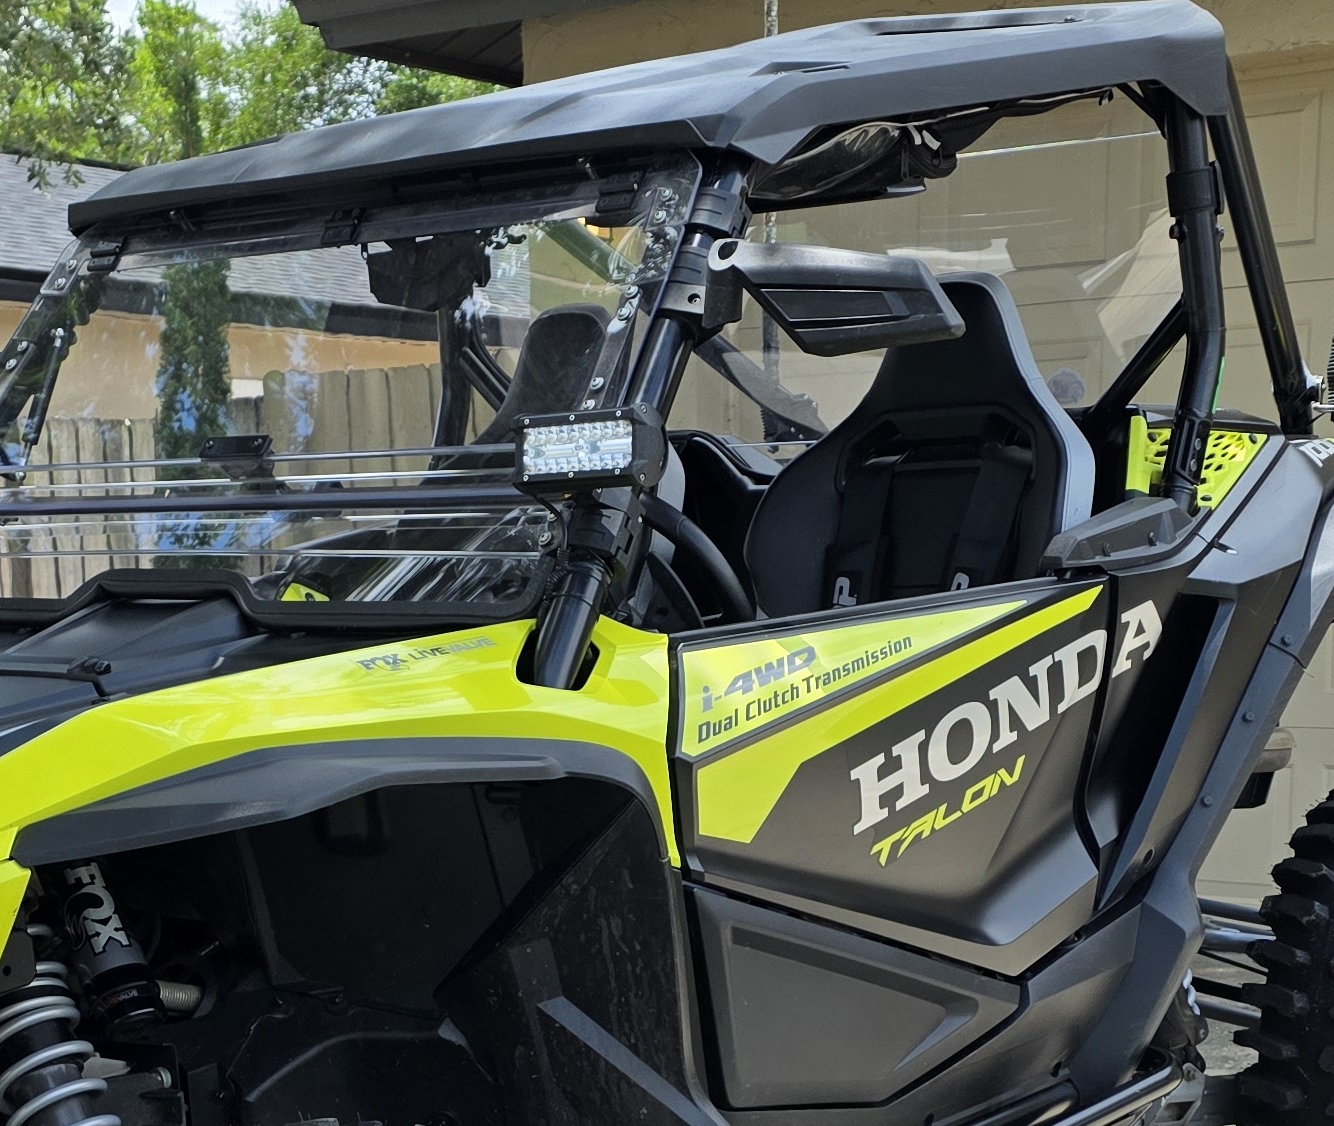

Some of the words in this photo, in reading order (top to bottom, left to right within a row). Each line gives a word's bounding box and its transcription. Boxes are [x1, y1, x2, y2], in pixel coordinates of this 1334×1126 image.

[356, 653, 409, 672] FOX
[697, 708, 739, 744] Dual
[745, 682, 800, 722] Clutch
[801, 635, 913, 694] Transmission
[701, 645, 817, 713] i-4WD
[849, 598, 1163, 835] HONDA
[870, 754, 1026, 868] TALON
[63, 862, 131, 954] FOX
